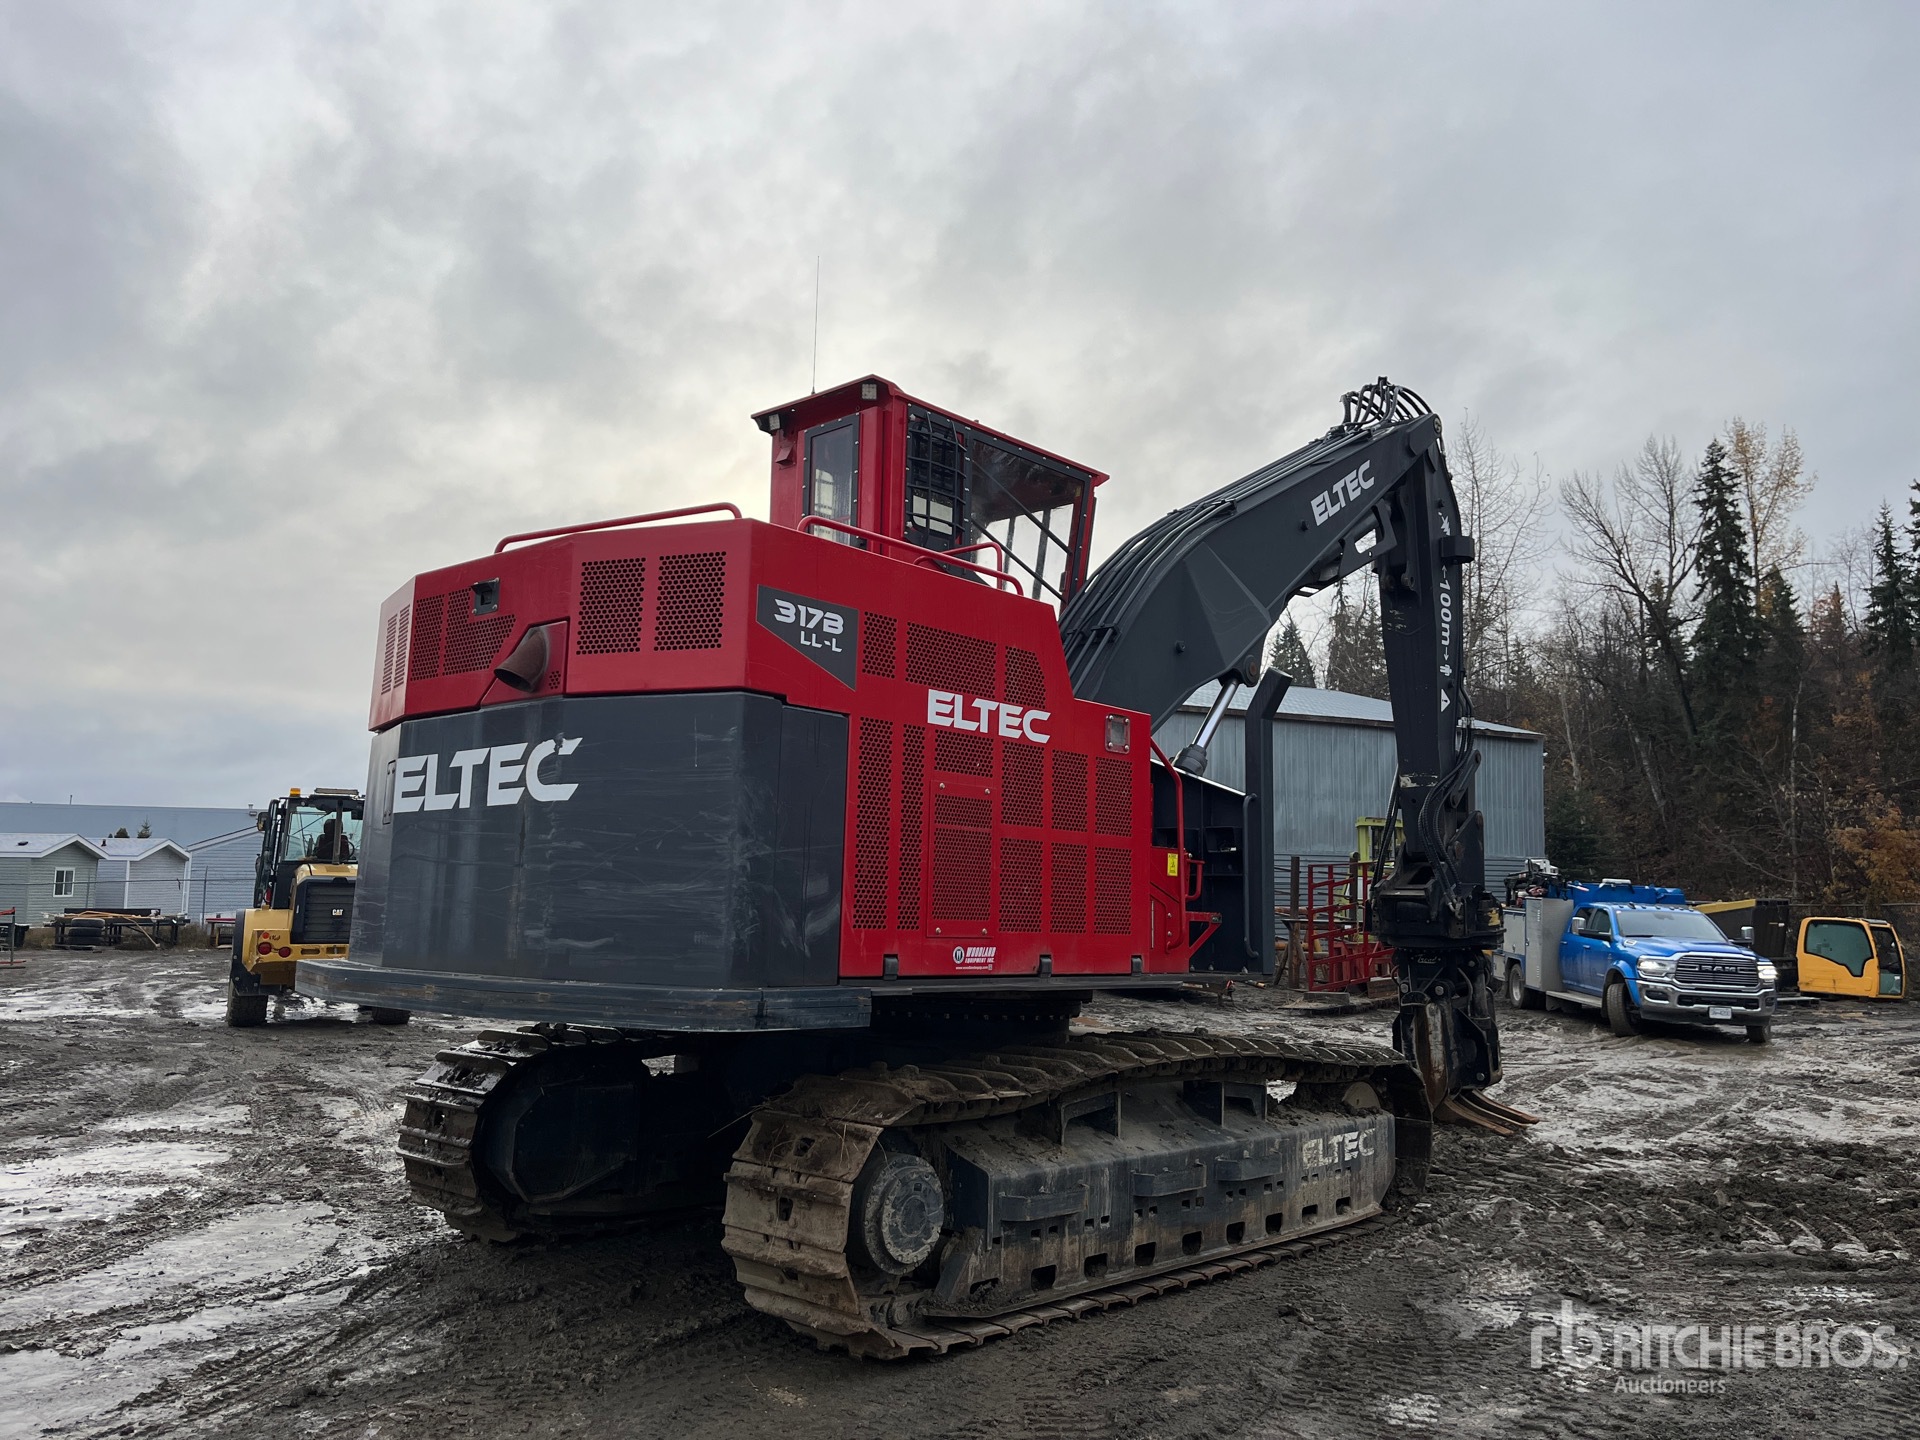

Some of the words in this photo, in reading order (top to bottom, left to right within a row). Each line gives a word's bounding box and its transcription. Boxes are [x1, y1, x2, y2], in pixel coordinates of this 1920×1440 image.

[1310, 459, 1375, 526] ELTEC
[773, 598, 844, 635] 317B
[1440, 579, 1452, 646] 100m
[800, 630, 843, 653] LL-L
[927, 688, 1052, 744] ELTEC
[393, 737, 583, 813] ELTEC
[332, 908, 343, 916] CAT
[1700, 965, 1737, 973] RAM
[1302, 1128, 1376, 1170] ELTEC
